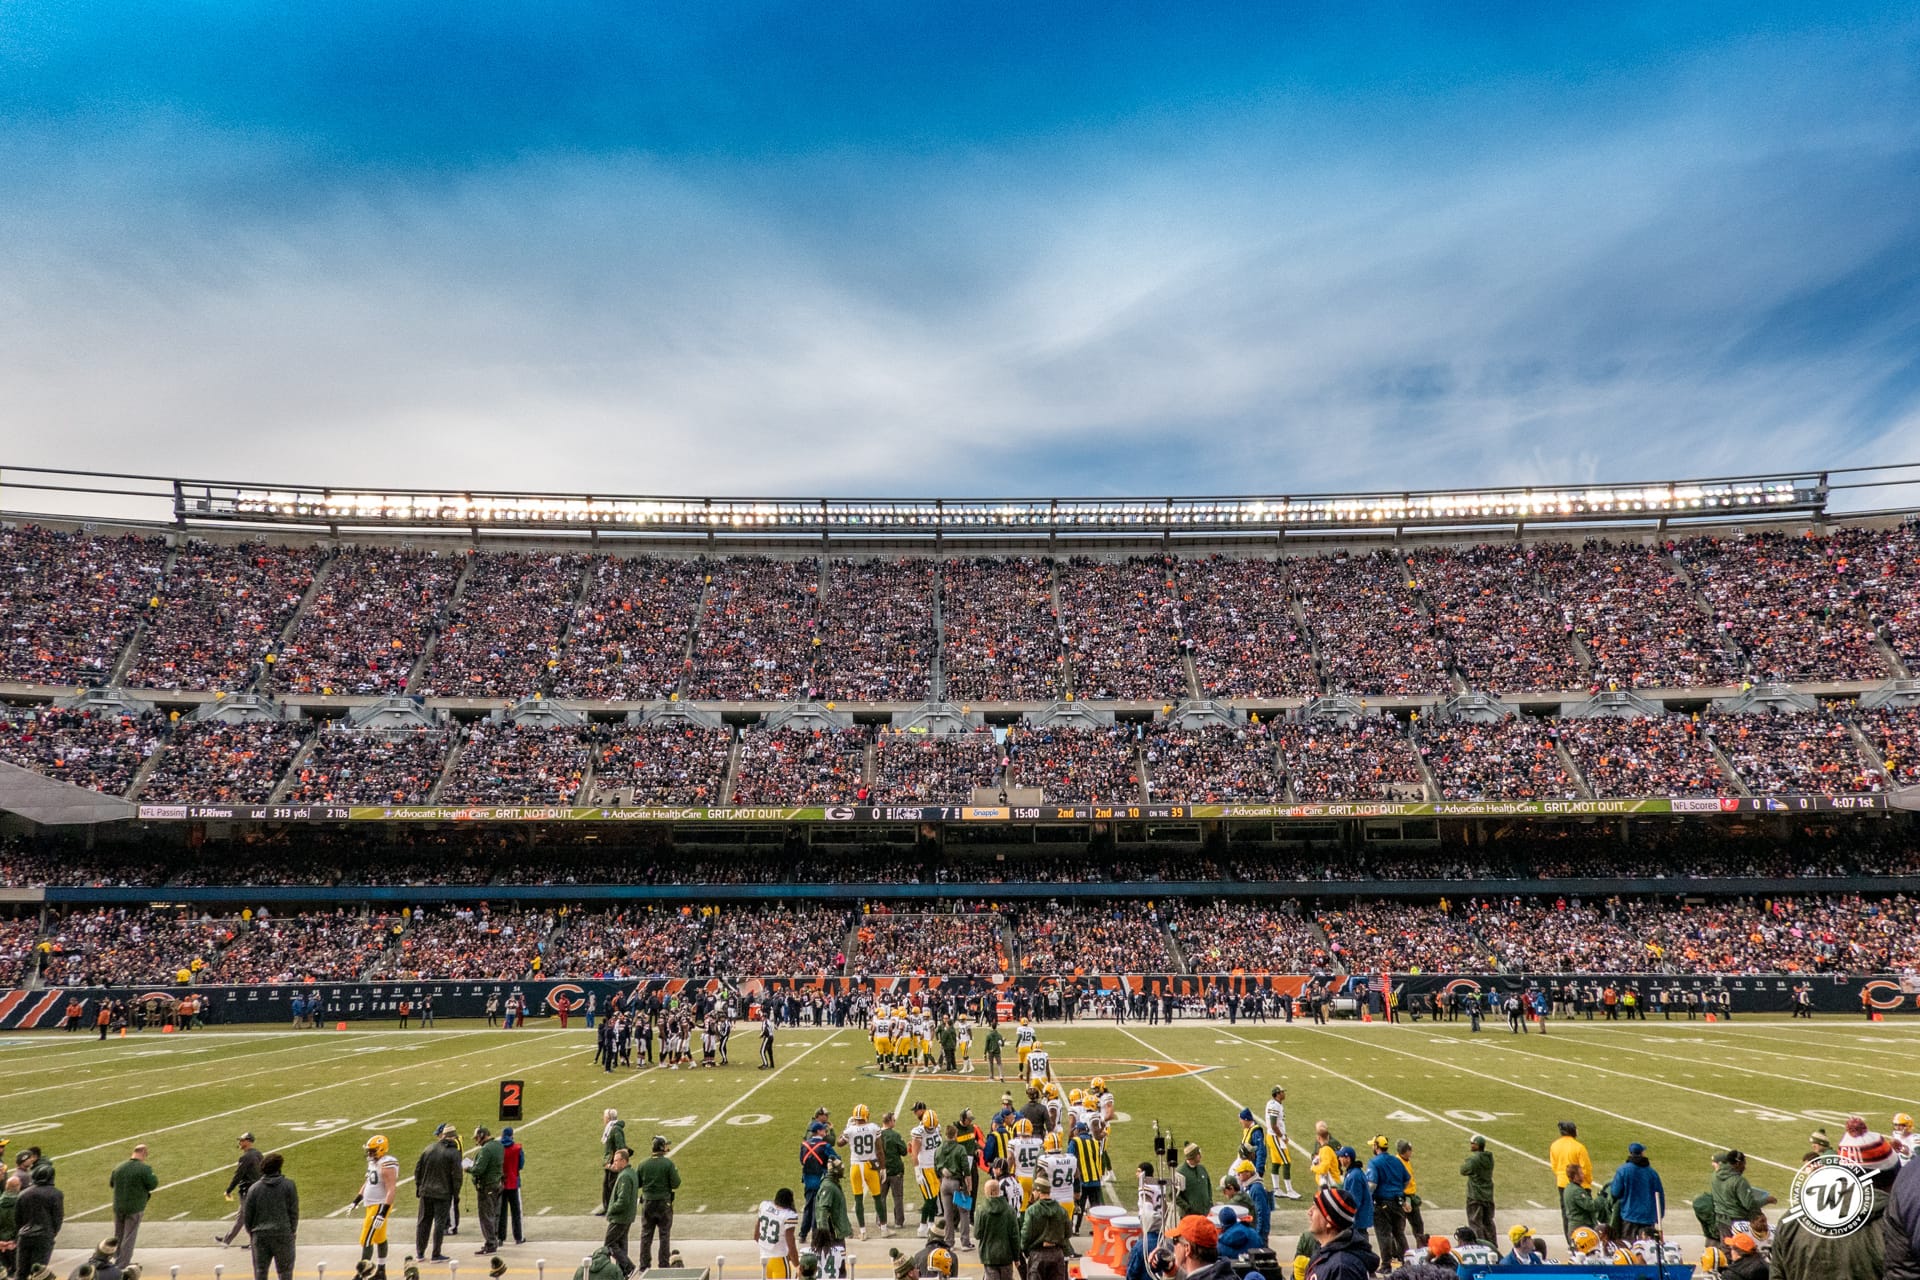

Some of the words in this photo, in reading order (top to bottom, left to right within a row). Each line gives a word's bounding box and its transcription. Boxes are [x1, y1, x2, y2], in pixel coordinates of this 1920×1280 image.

[1444, 804, 1484, 814] Advocate
[1486, 804, 1515, 813] Health
[1517, 803, 1538, 813] Care
[1544, 803, 1571, 813] GRIT,
[1572, 802, 1595, 812] NOT
[1597, 801, 1627, 812] QUIT.
[1674, 801, 1687, 810] NFL
[1689, 801, 1718, 810] Scores
[1753, 799, 1760, 809] 0
[1800, 799, 1808, 809] 0
[1832, 798, 1854, 808] 4:07
[1857, 798, 1874, 808] 1st
[141, 808, 155, 817] NFL
[157, 808, 185, 818] Passing
[190, 808, 198, 817] 1.
[199, 808, 233, 818] P.Rivers
[251, 809, 265, 818] LAC
[273, 808, 290, 818] 313
[294, 808, 307, 819] yds
[327, 808, 333, 818] 2
[335, 808, 347, 818] TDs
[394, 808, 436, 818] Advocate
[438, 808, 467, 818] Health
[469, 808, 490, 818] Care
[495, 808, 521, 819] GRIT,
[523, 808, 546, 818] NOT
[547, 808, 574, 819] QUIT.
[611, 810, 651, 819] Advocate
[653, 810, 681, 819] Health
[682, 810, 702, 819] Care
[707, 809, 732, 820] GRIT,
[734, 809, 756, 819] NOT
[758, 809, 784, 819] QUIT.
[872, 808, 880, 819] 0
[941, 808, 949, 819] 7
[1014, 808, 1040, 818] 15:00
[1057, 808, 1074, 818] 2nd
[1075, 810, 1086, 818] QTR
[1095, 808, 1112, 818] 2nd
[1114, 810, 1125, 818] AND
[1128, 808, 1139, 818] 10
[1149, 810, 1157, 818] ON
[1159, 810, 1168, 818] THE
[1171, 808, 1183, 818] 39
[1232, 806, 1275, 816] Advocate
[1276, 806, 1301, 816] Health
[1303, 805, 1323, 815] Care
[1328, 805, 1354, 816] GRIT,
[1356, 805, 1378, 815] NOT
[1380, 804, 1407, 815] QUIT.
[349, 1002, 364, 1011] OF
[372, 1001, 423, 1011] FAMRS
[1022, 1031, 1032, 1041] 12
[1032, 1058, 1046, 1071] 83
[503, 1084, 521, 1106] 2
[853, 1134, 874, 1155] 89
[1018, 1148, 1039, 1168] 45
[1840, 1146, 1864, 1163] CHI
[1052, 1168, 1074, 1188] 64
[759, 1215, 780, 1244] 33
